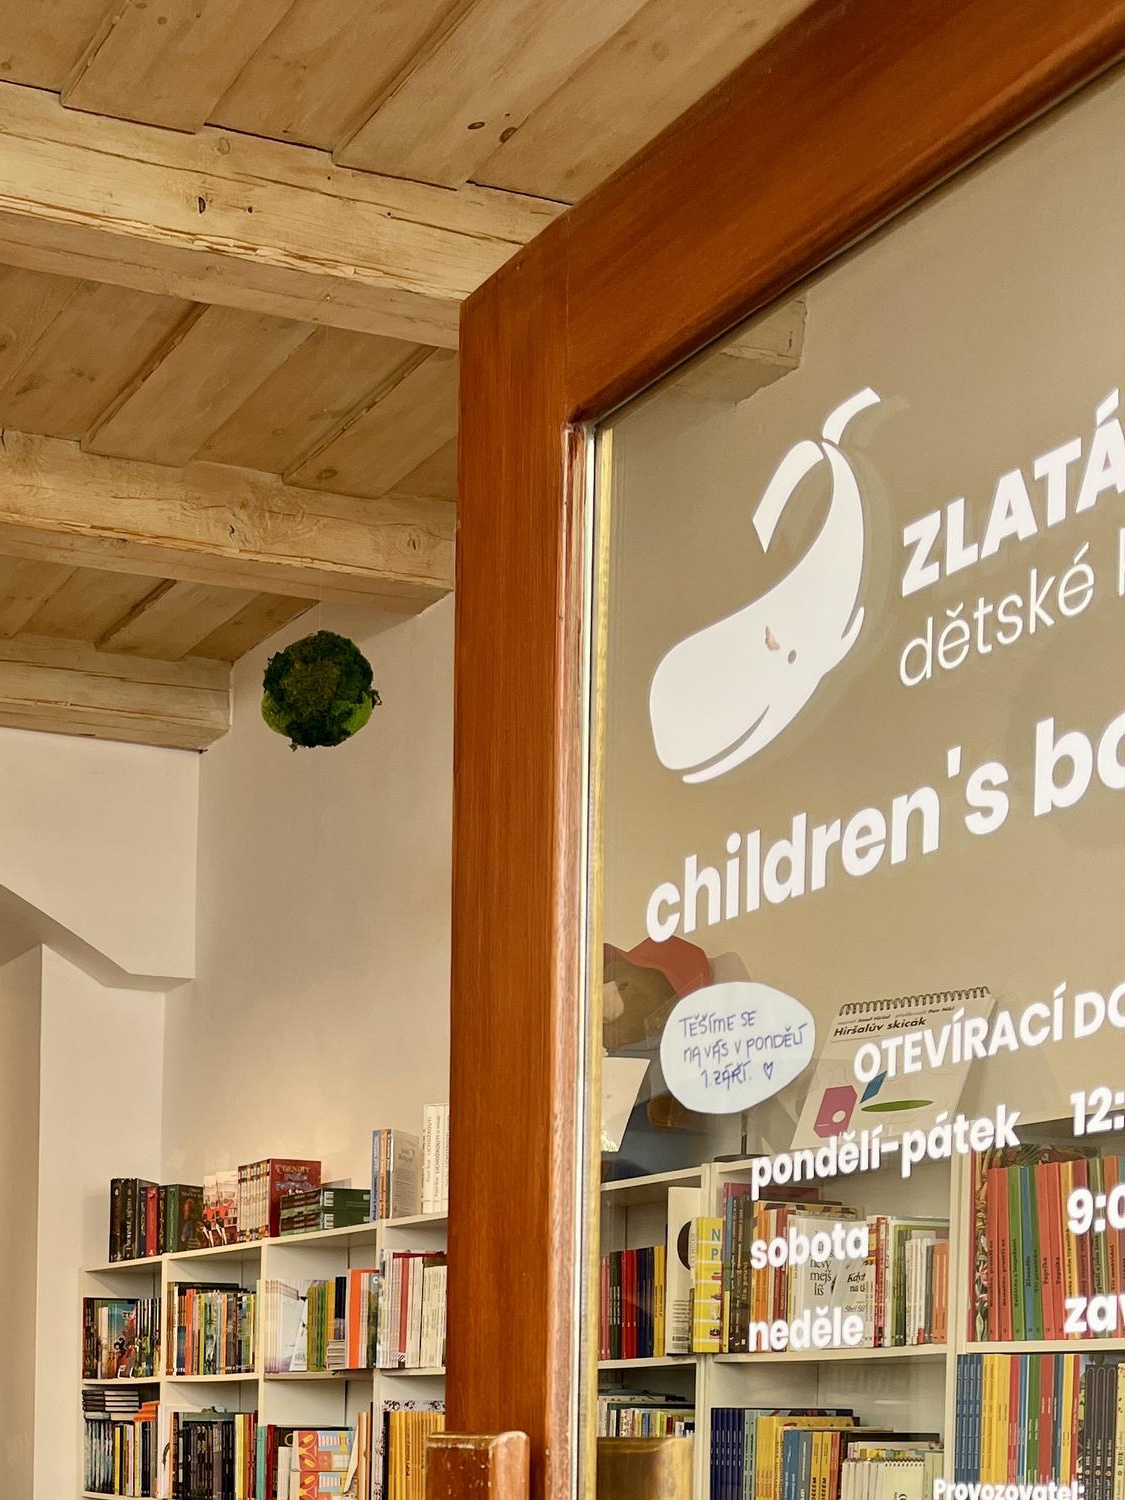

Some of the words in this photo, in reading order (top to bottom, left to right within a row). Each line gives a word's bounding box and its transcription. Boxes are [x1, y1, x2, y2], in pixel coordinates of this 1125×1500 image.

[902, 388, 1125, 599] ZLATÁ
[899, 543, 1096, 687] dětské
[646, 746, 1010, 943] children's
[678, 1012, 736, 1037] TĚŠÍME
[741, 1010, 757, 1027] SE
[705, 1039, 729, 1064] VÁS
[746, 1023, 808, 1058] PONDĚLÍ
[853, 983, 1067, 1083] OTEVÍRACÍ
[886, 1016, 927, 1030] skicák
[751, 1105, 1020, 1200] pondělí-pátek
[750, 1223, 869, 1270] sobota
[748, 1306, 864, 1352] neděle
[1063, 1295, 1125, 1334] za
